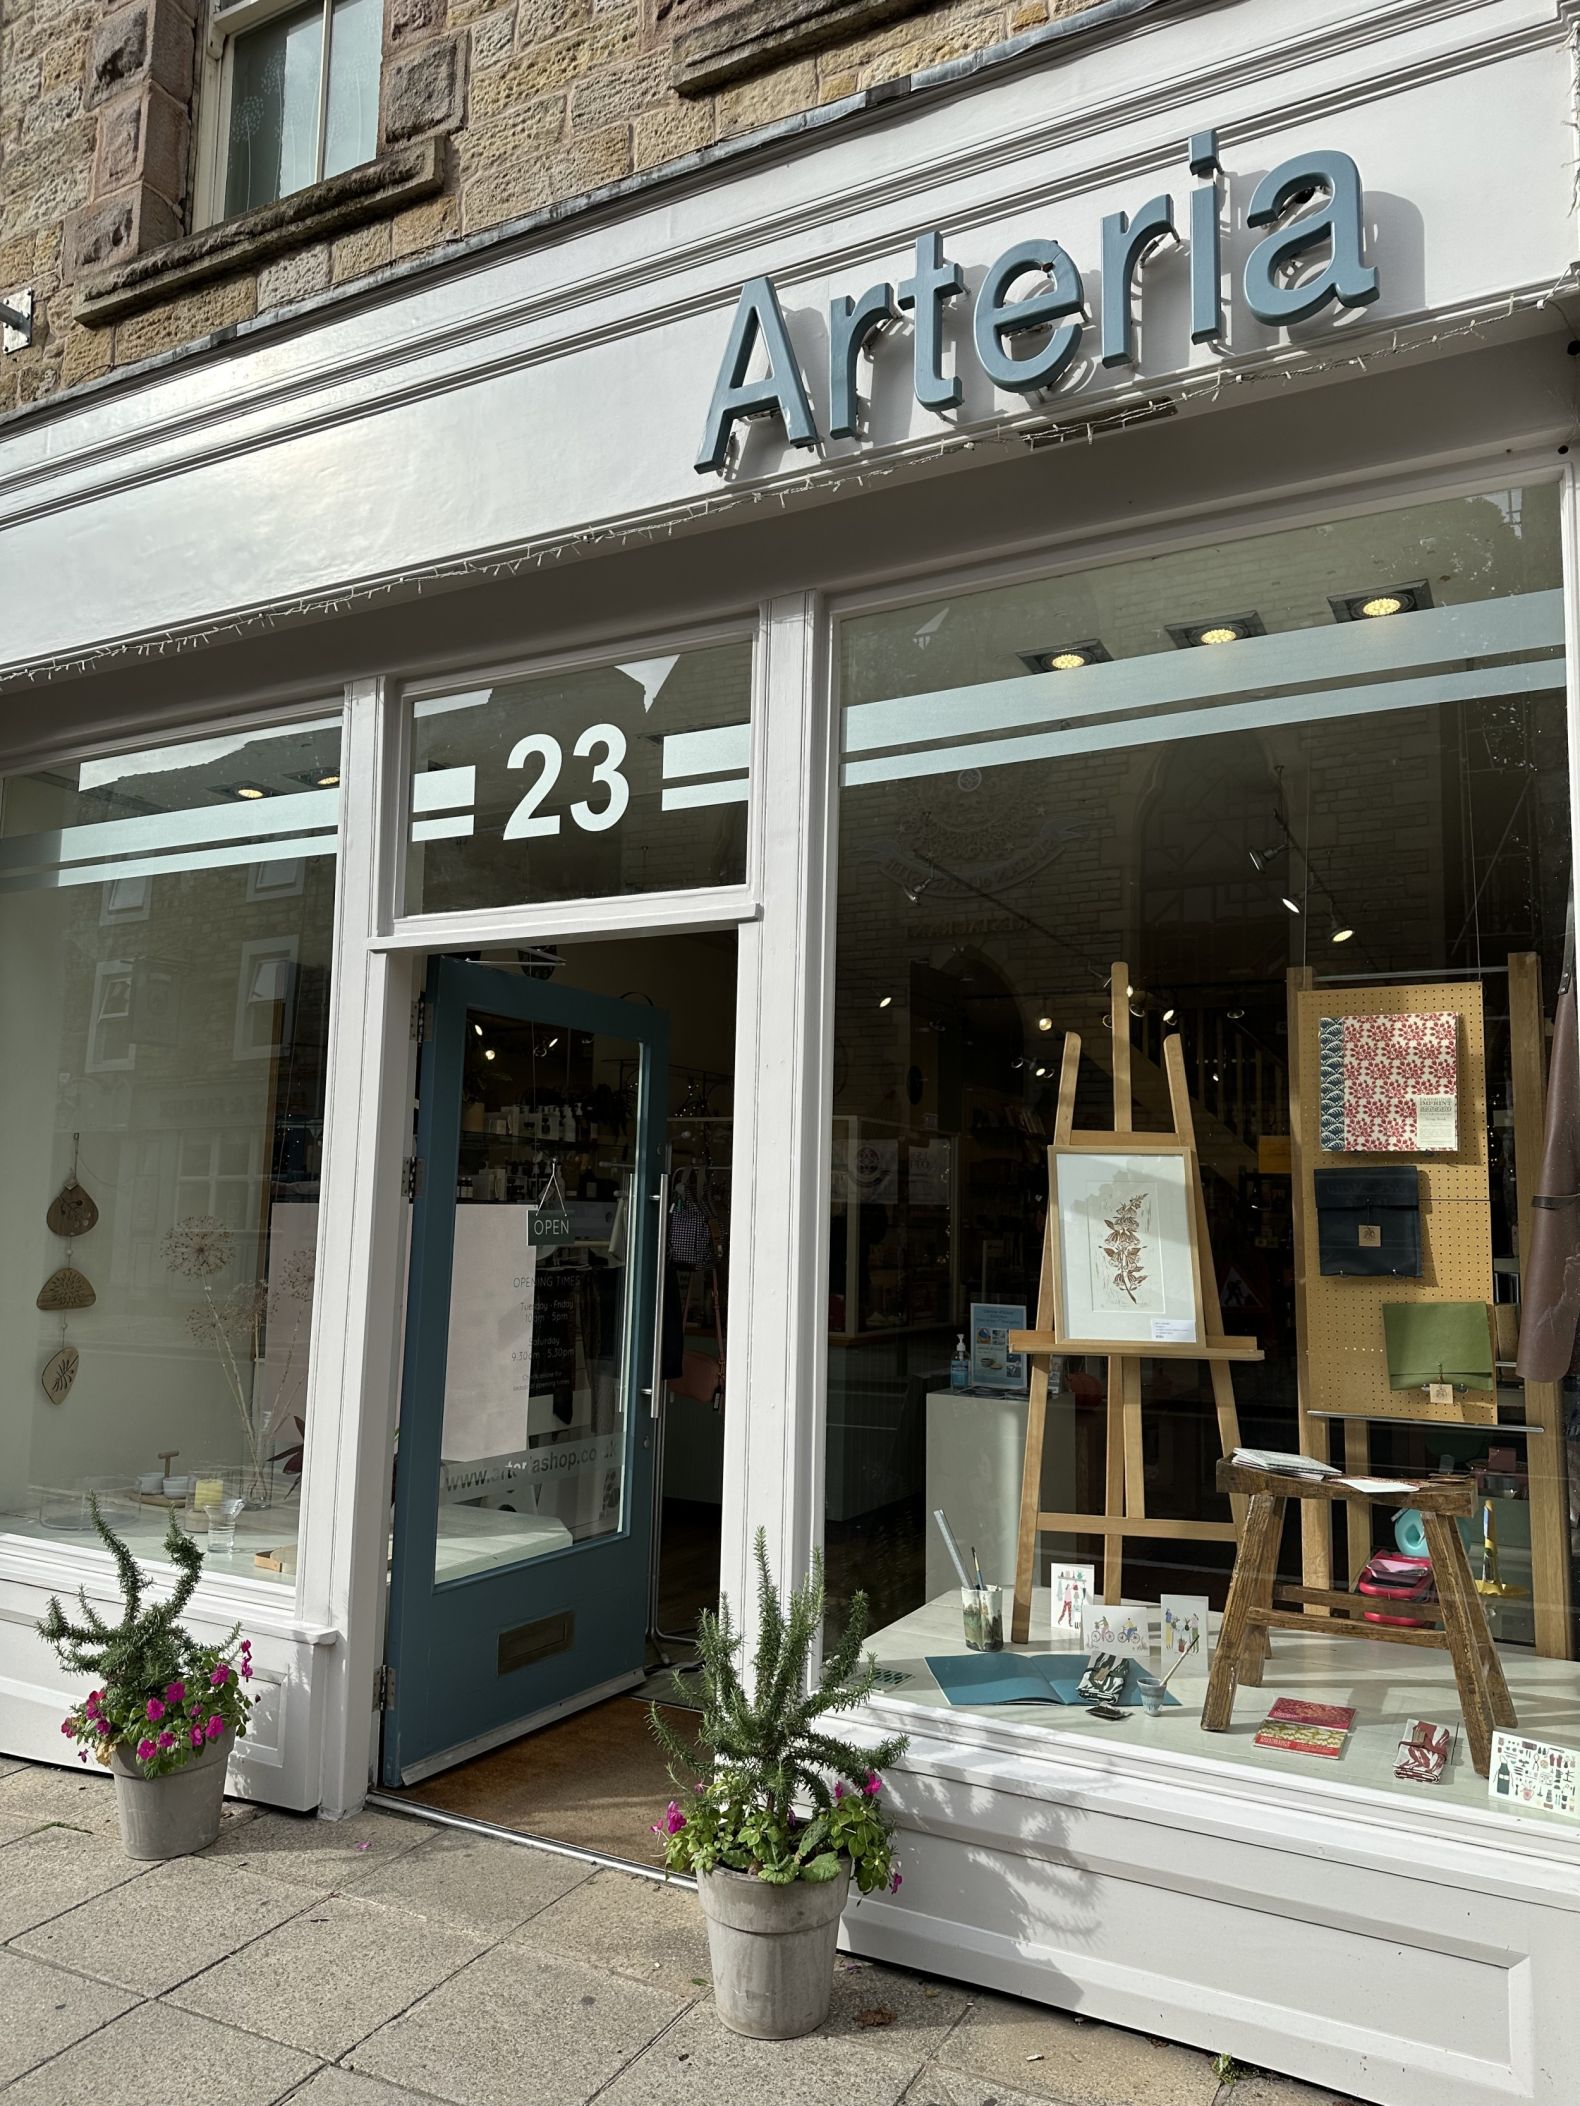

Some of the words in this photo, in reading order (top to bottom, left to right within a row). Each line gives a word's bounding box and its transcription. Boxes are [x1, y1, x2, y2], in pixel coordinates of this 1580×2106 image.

[693, 128, 1381, 474] Arteria
[503, 723, 630, 841] 23
[533, 1219, 569, 1236] OPEN
[513, 1275, 553, 1288] OPENING
[556, 1275, 581, 1287] TIMES
[553, 1299, 574, 1310] Friday
[551, 1312, 568, 1321] 5pm
